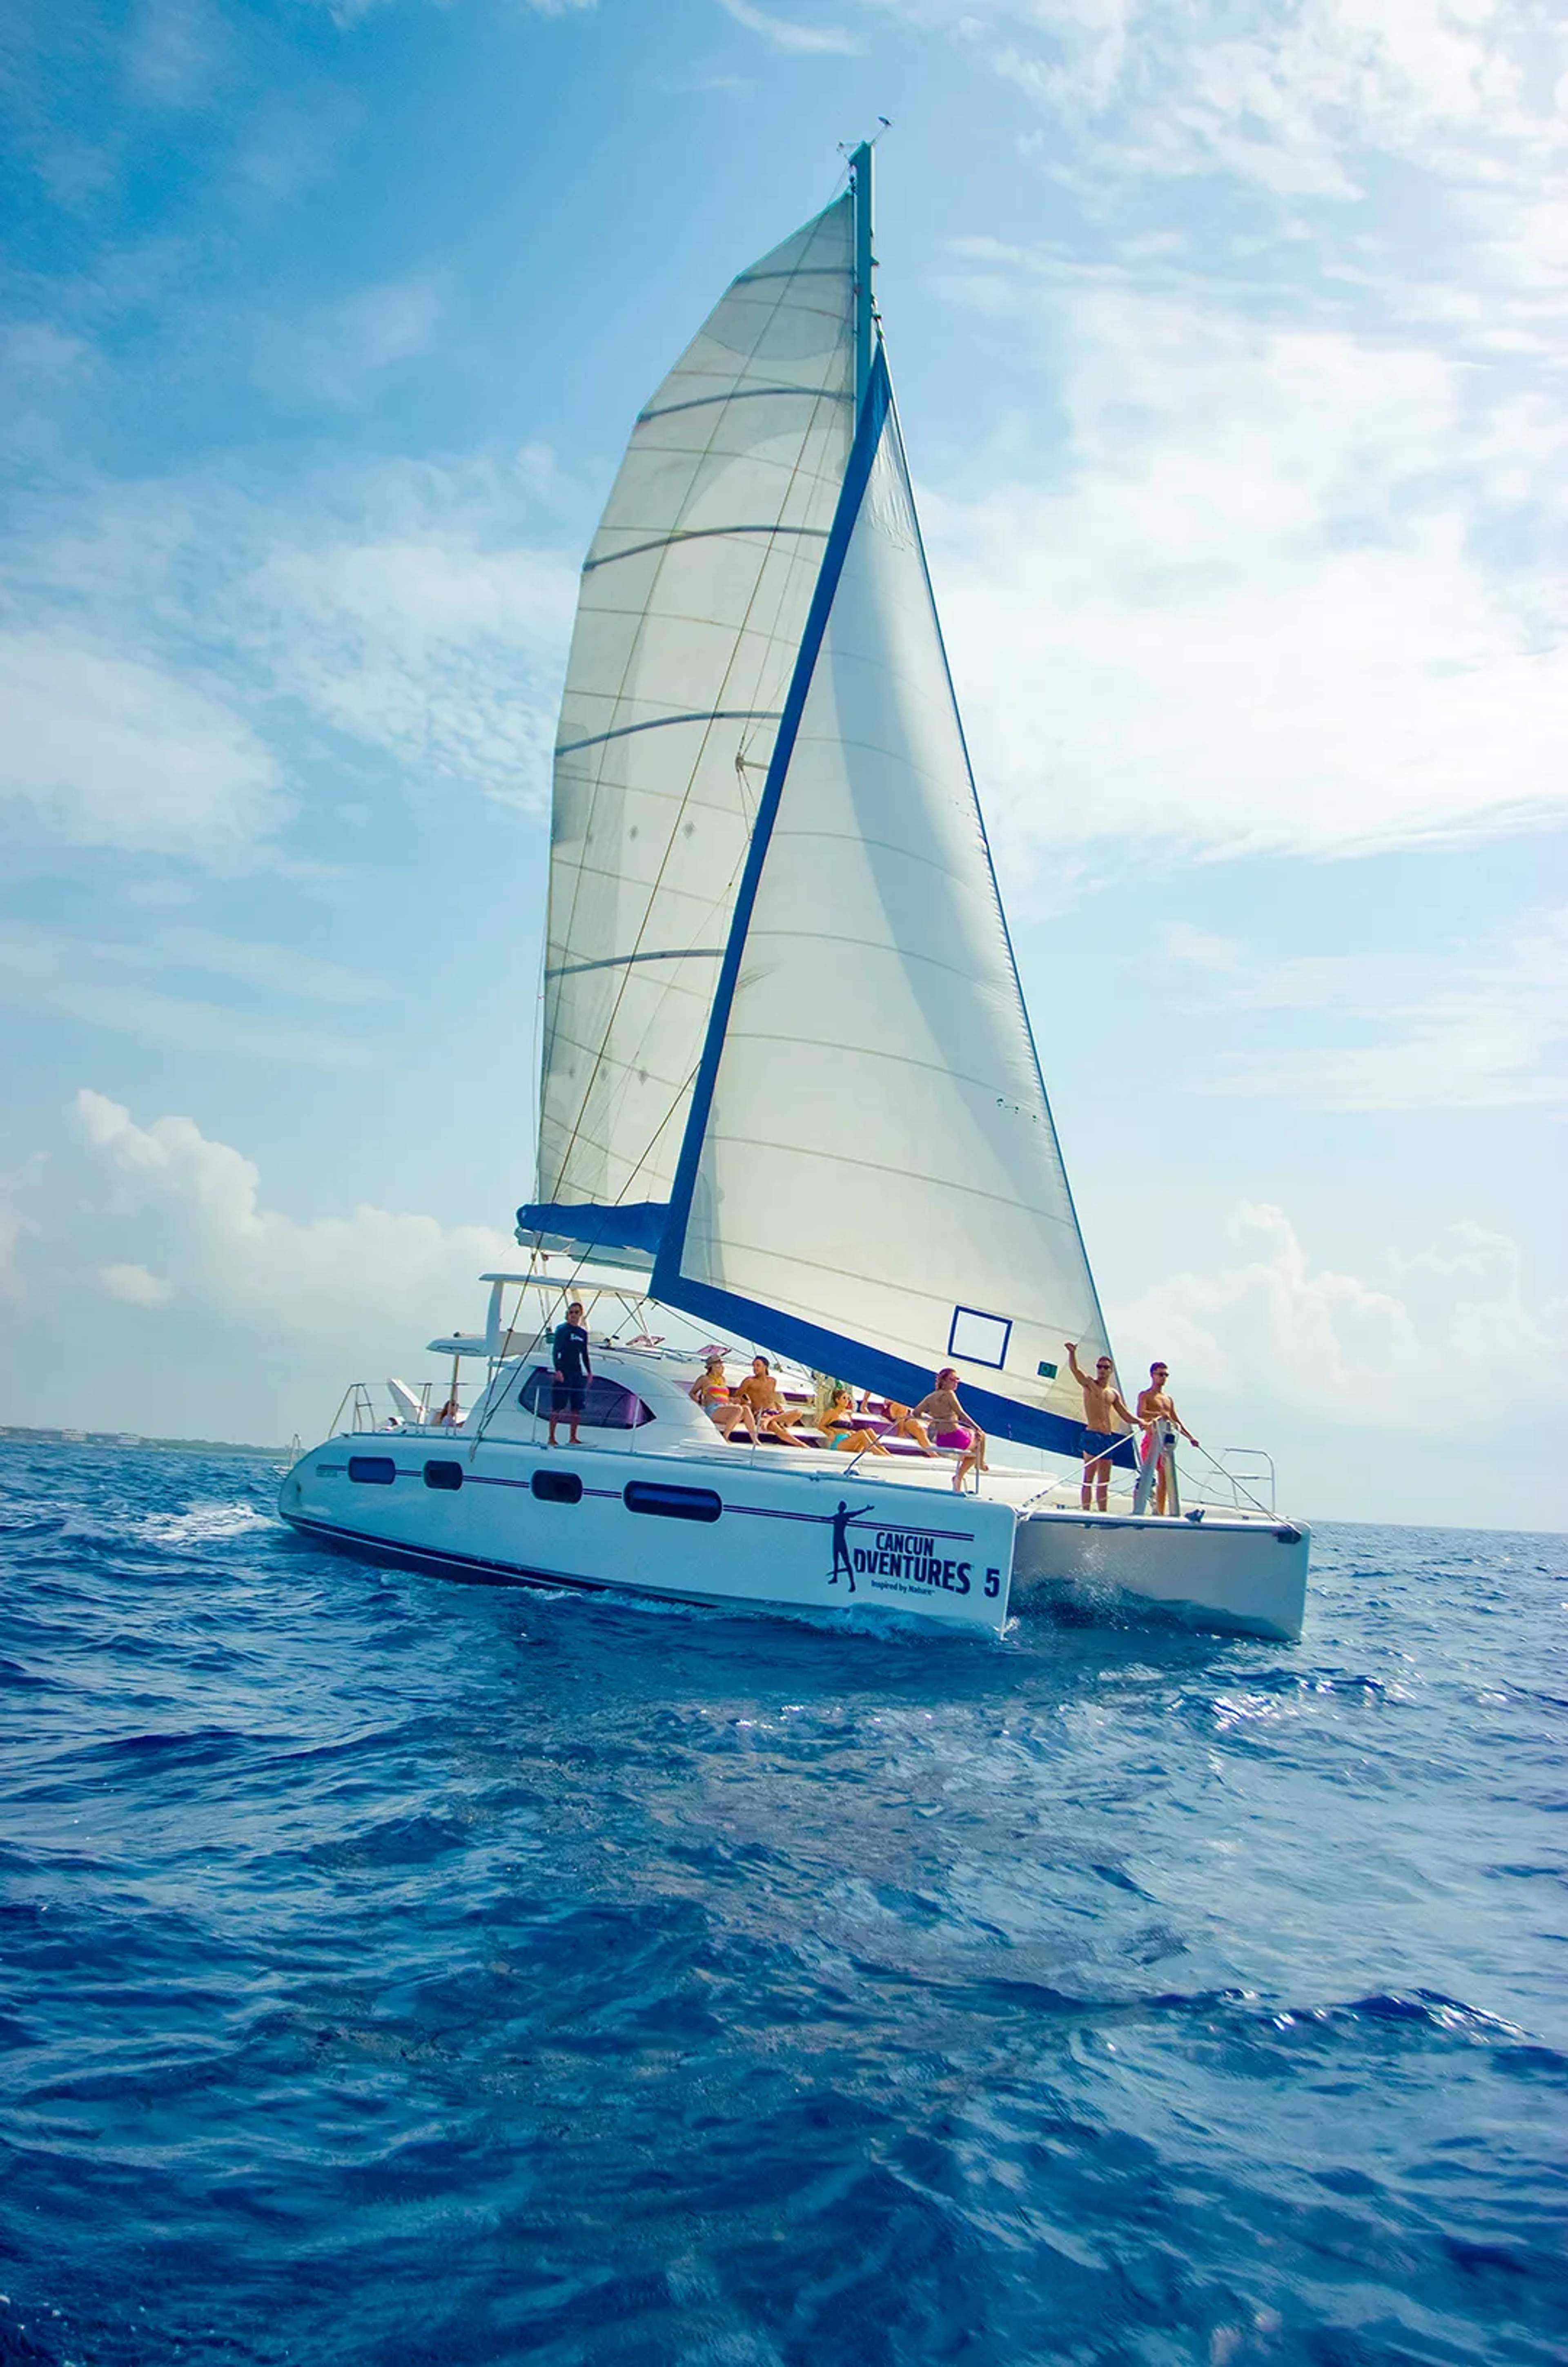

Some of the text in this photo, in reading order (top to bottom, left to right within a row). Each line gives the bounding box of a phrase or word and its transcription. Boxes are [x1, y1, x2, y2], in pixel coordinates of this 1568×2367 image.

[875, 1532, 934, 1557] CANCUN
[871, 1579, 898, 1590] Inspired
[899, 1583, 907, 1594] by
[984, 1567, 1000, 1598] 5
